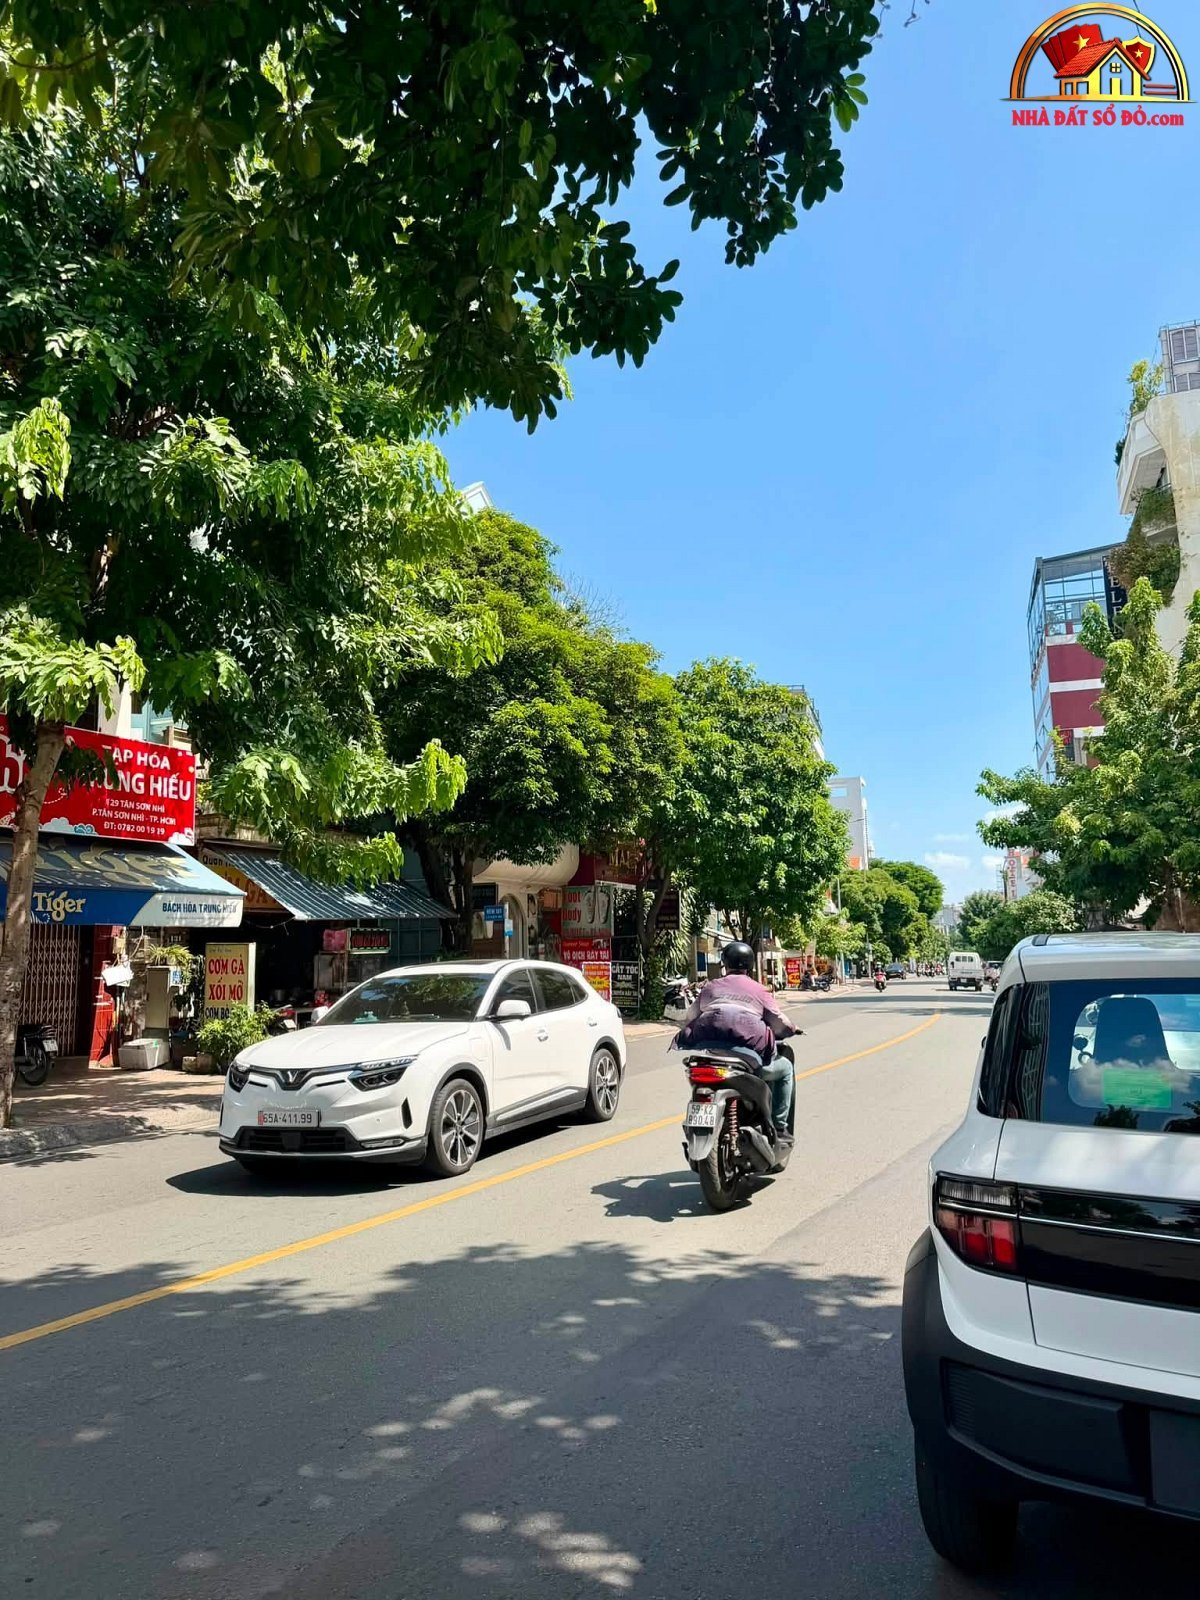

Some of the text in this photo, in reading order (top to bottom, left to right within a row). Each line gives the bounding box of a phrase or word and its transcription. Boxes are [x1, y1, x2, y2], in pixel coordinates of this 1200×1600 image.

[136, 752, 171, 770] HÓA
[150, 772, 191, 801] HIẾU
[120, 800, 135, 809] TÂN
[136, 802, 151, 811] SƠN
[92, 808, 113, 818] P.TÂN
[114, 811, 130, 819] SƠN
[131, 812, 144, 822] NHÌ
[104, 821, 116, 830] ĐT:
[33, 890, 86, 922] Tiger
[162, 900, 181, 912] BÁCH
[183, 901, 197, 913] HÓA
[199, 903, 222, 913] TRUNG
[208, 956, 228, 975] CƠM
[209, 976, 226, 1000] XỐI
